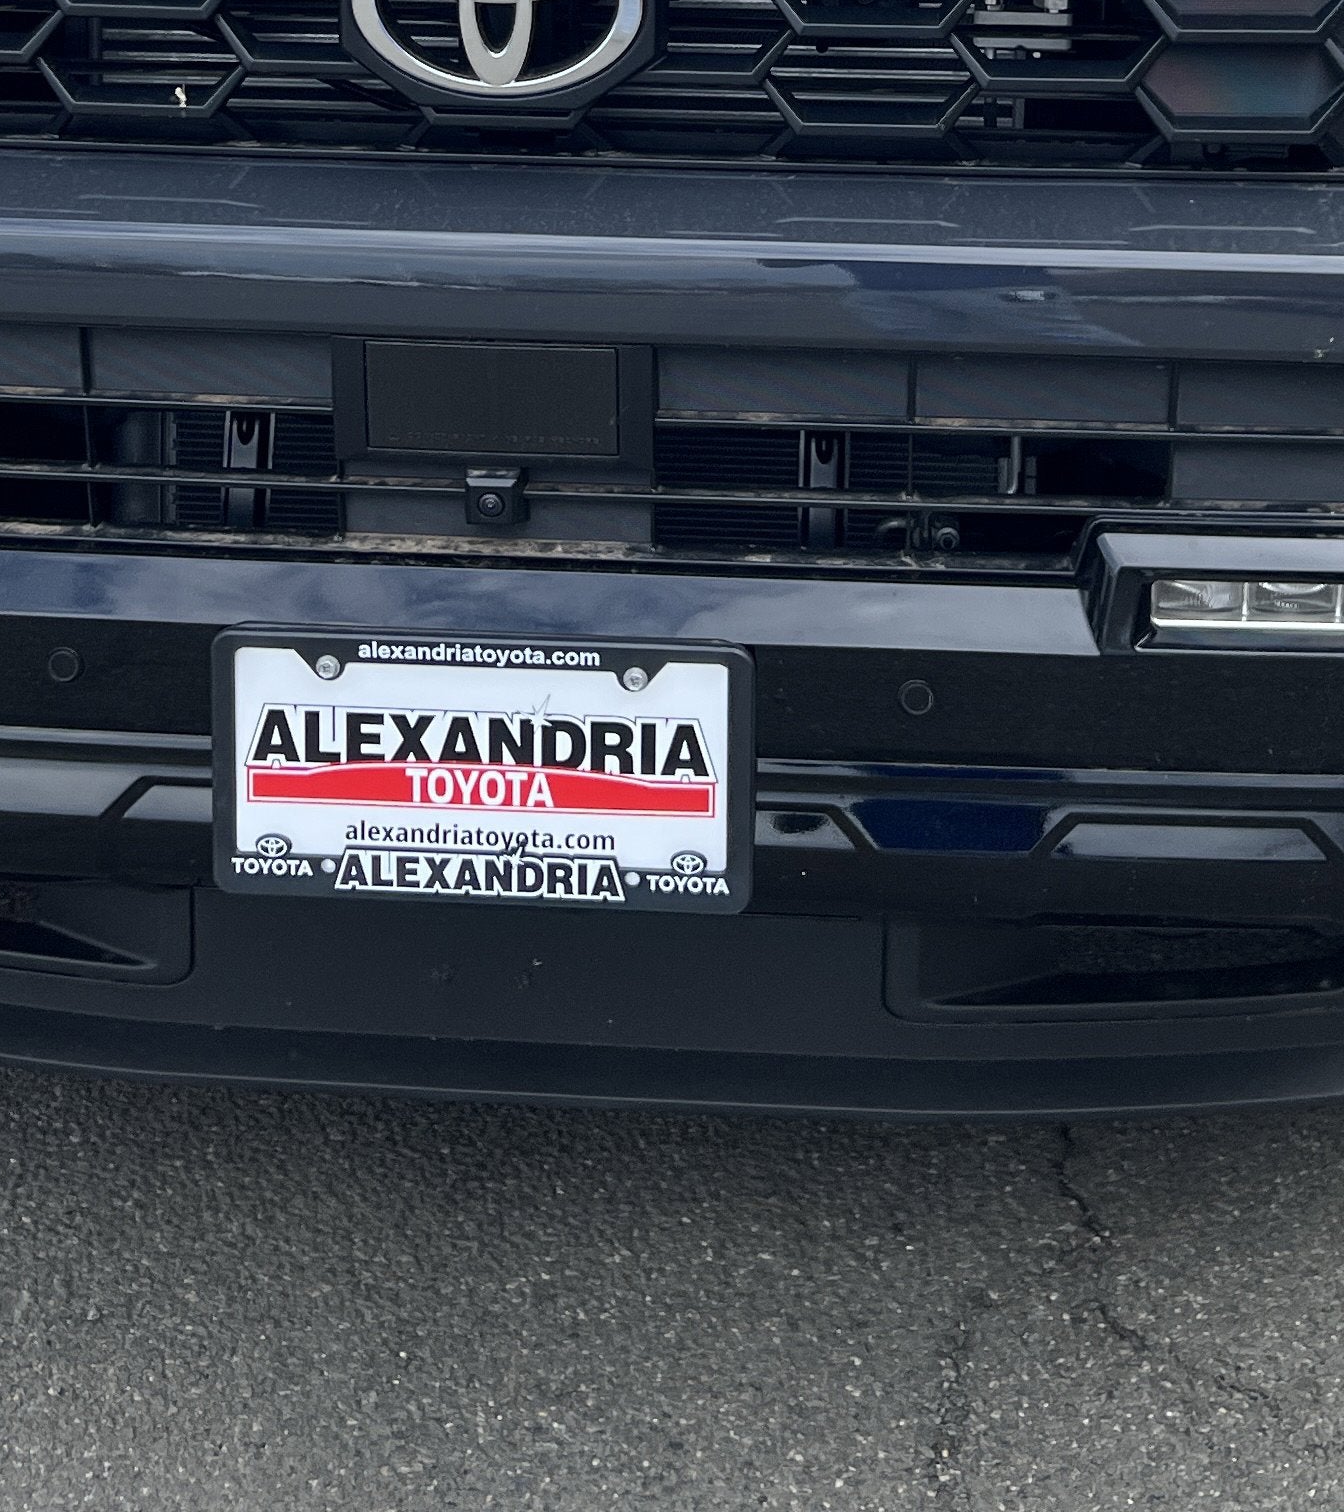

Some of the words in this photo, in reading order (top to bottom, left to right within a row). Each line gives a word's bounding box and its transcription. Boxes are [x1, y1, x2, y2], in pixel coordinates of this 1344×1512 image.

[358, 641, 601, 668] alexandriatoyota.com
[252, 707, 714, 778] ALEXANDRIA
[406, 768, 554, 808] TOYOTA
[345, 819, 616, 851] alexandriatoyota.com
[231, 857, 314, 877] TOYOTA
[337, 851, 623, 900] ALEXANDRIA
[646, 874, 731, 895] TOYOTA
